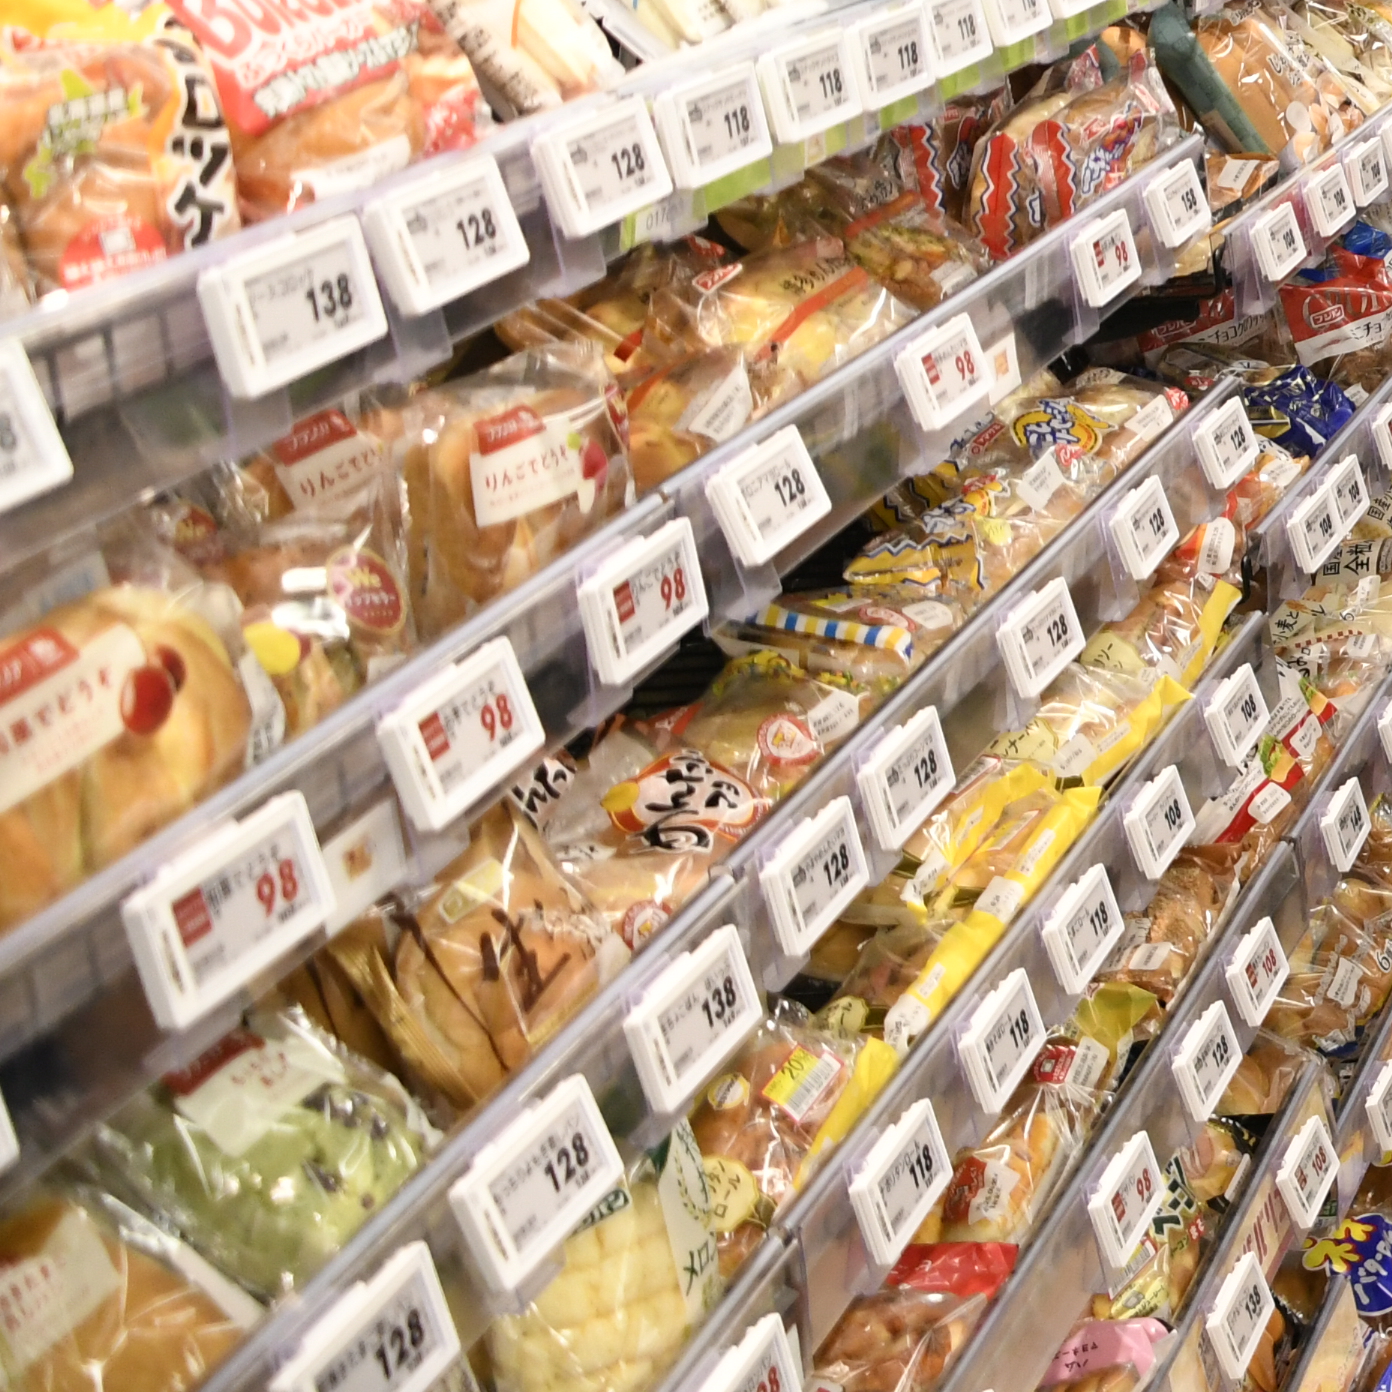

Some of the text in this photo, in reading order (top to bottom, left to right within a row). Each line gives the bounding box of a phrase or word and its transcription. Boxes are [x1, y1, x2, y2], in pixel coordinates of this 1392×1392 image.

[957, 13, 977, 43] 118
[897, 42, 919, 73] 118
[819, 68, 843, 99] 118
[724, 110, 750, 141] 118
[611, 145, 645, 181] 128
[1182, 185, 1199, 211] 158
[457, 209, 497, 252] 128
[1114, 241, 1129, 266] 98
[305, 273, 353, 323] 138
[955, 352, 976, 382] 98
[1230, 428, 1246, 450] 128
[774, 469, 806, 508] 128
[1348, 481, 1361, 499] 108
[1150, 509, 1165, 532] 128
[1318, 517, 1333, 536] 108
[660, 566, 687, 607] 98
[1046, 614, 1069, 647] 128
[481, 692, 514, 741] 98
[1240, 693, 1257, 723] 108
[913, 748, 939, 790] 128
[1164, 798, 1184, 828] 108
[822, 842, 850, 887] 128
[257, 859, 299, 917] 98
[1089, 899, 1110, 934] 118
[1262, 948, 1276, 978] 108
[701, 976, 738, 1028] 138
[1008, 1007, 1031, 1050] 118
[1213, 1036, 1232, 1069] 128
[543, 1132, 590, 1194] 128
[908, 1146, 934, 1189] 118
[1310, 1149, 1327, 1178] 108
[1135, 1168, 1153, 1204] 98
[1242, 1289, 1261, 1319] 138
[376, 1308, 426, 1379] 128
